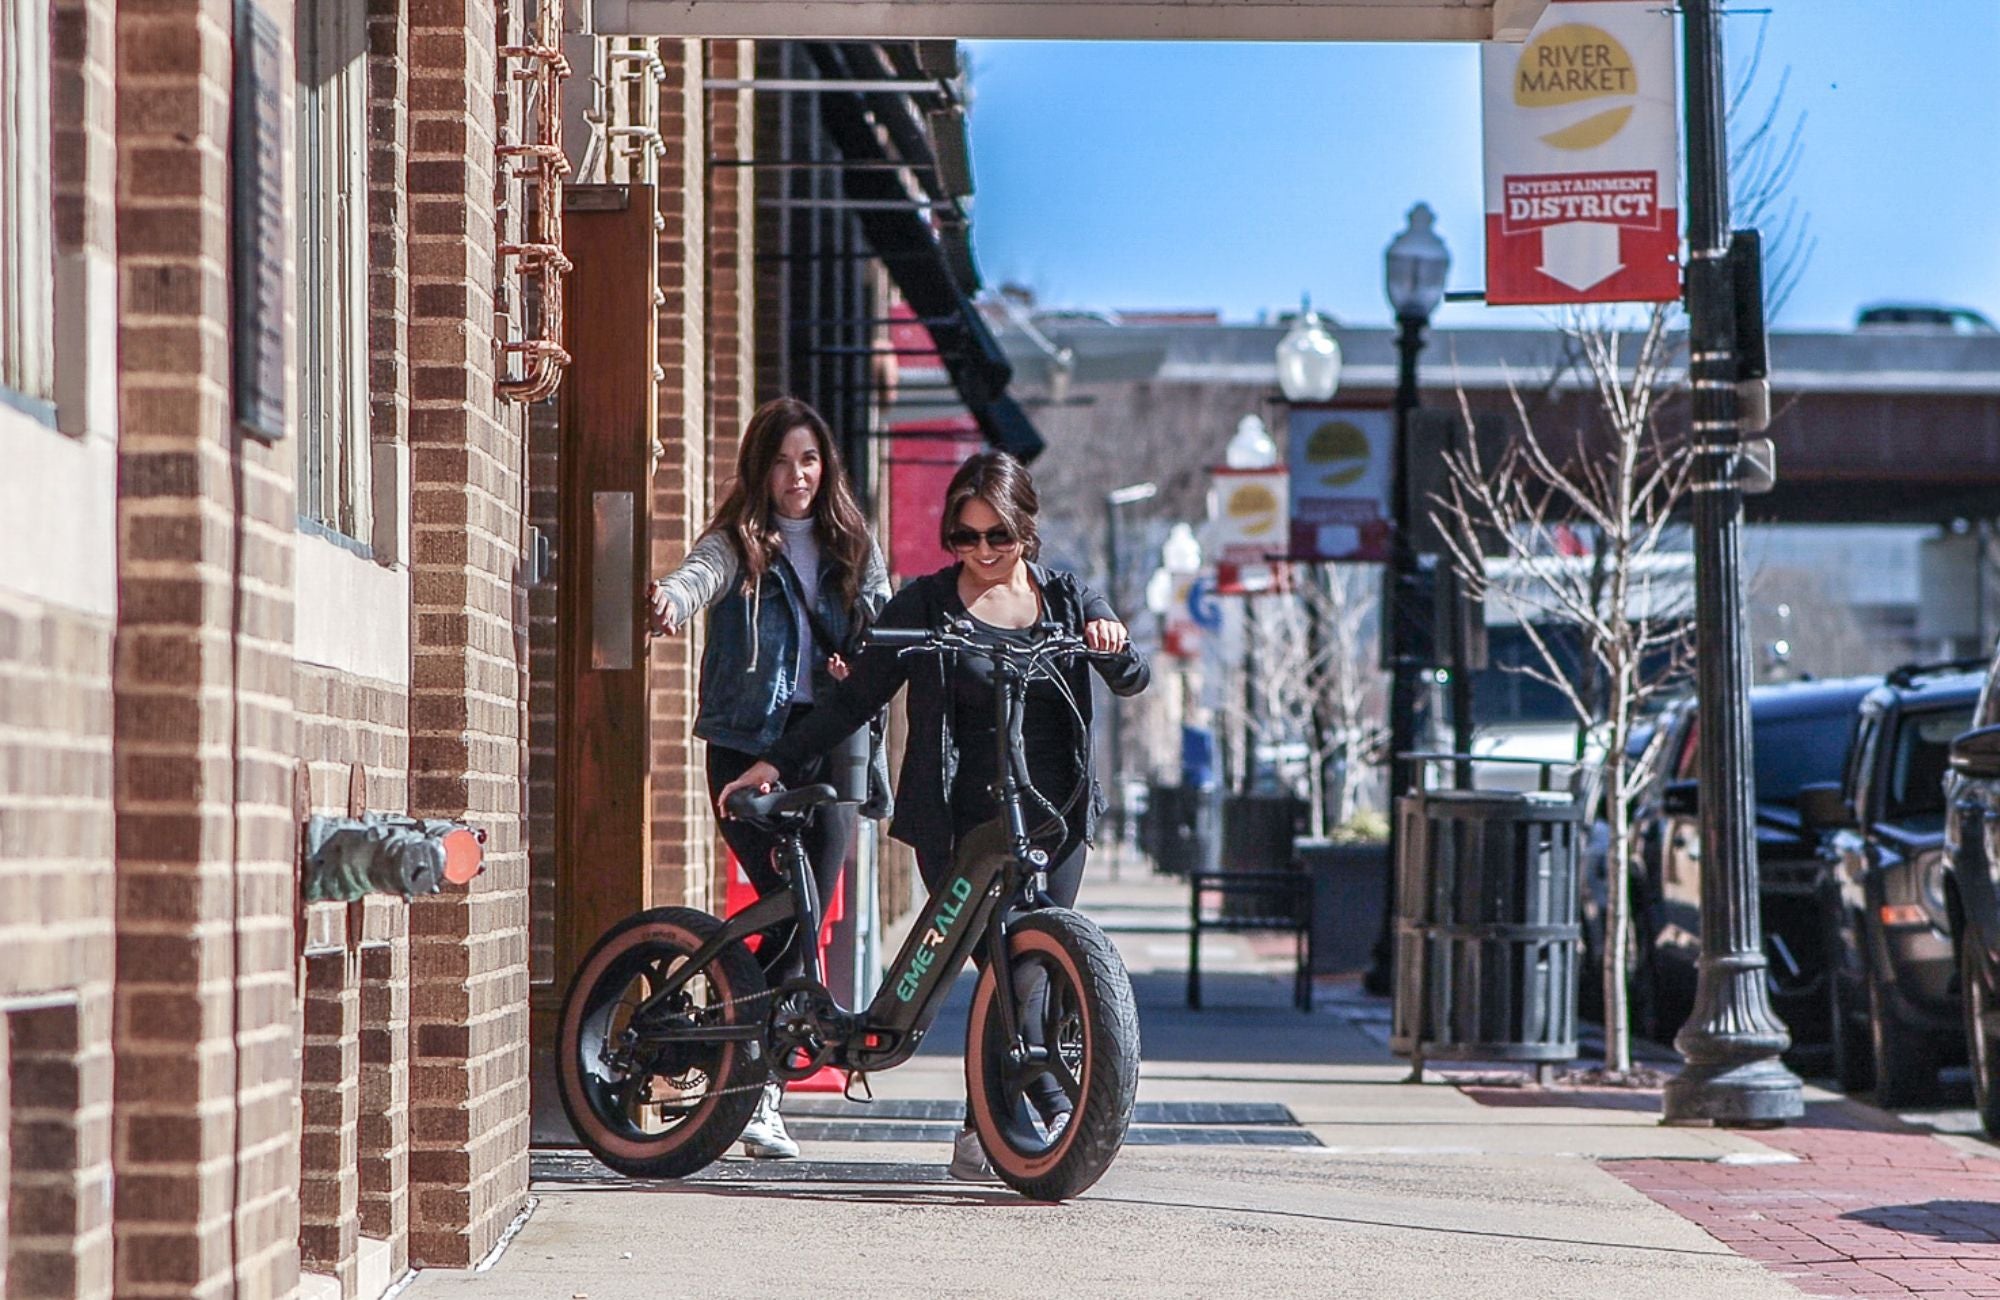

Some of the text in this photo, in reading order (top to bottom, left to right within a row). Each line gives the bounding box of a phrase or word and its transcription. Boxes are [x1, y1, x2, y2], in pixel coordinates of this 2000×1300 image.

[1538, 45, 1611, 67] RIVER
[1520, 68, 1630, 92] MARKET
[1508, 178, 1652, 195] ENTERTAINMENT
[1511, 196, 1652, 220] DISTRICT
[896, 877, 972, 1002] EMERALD
